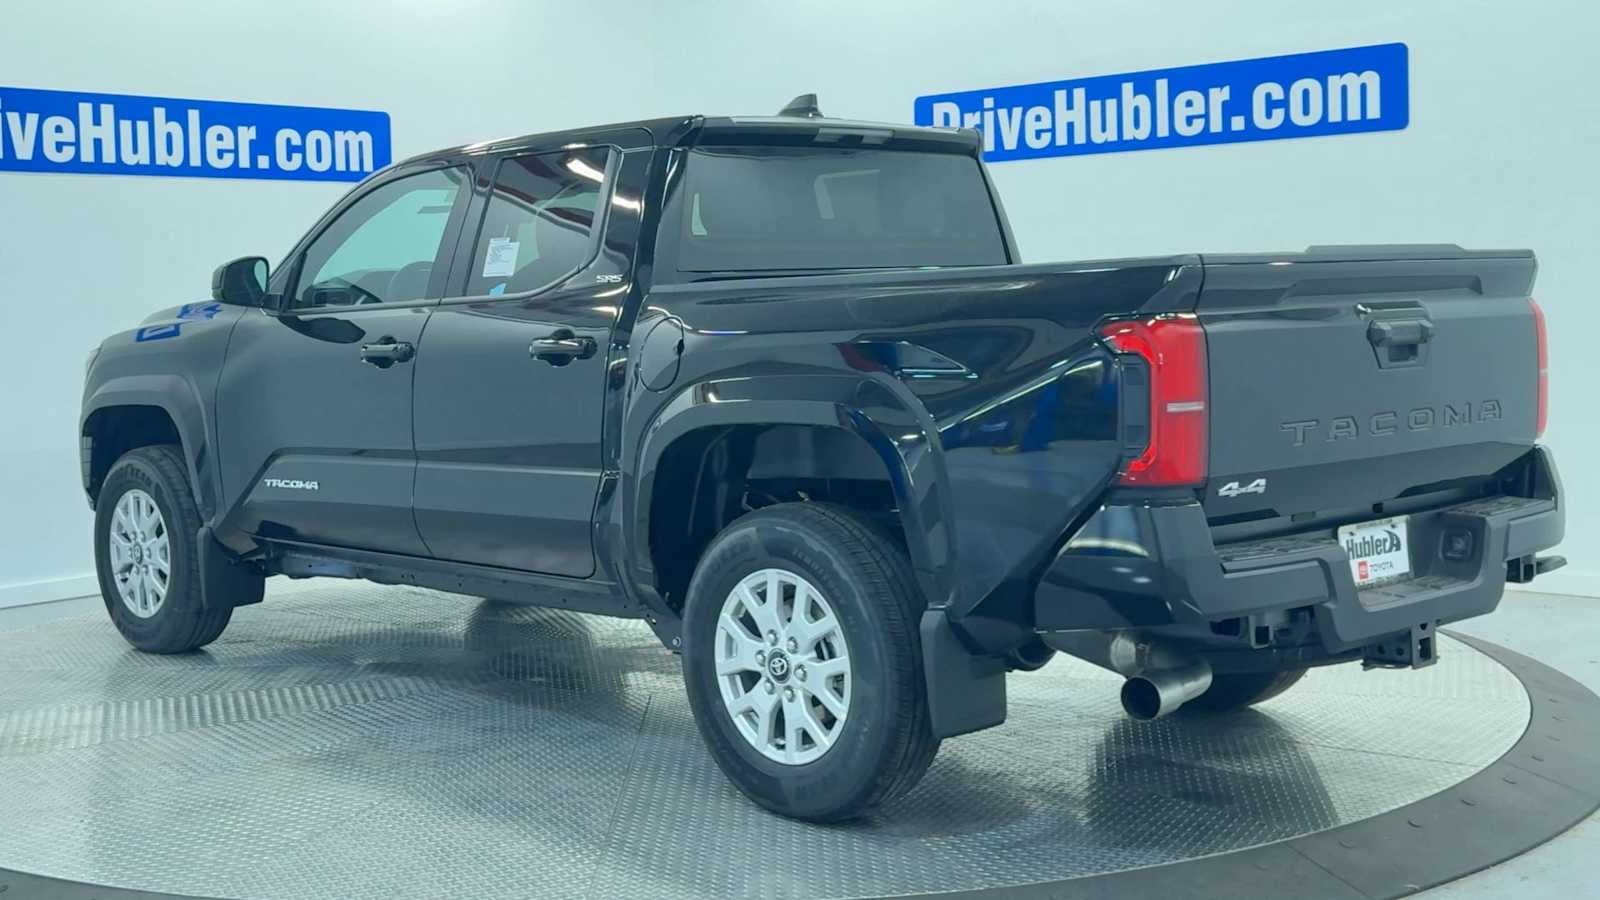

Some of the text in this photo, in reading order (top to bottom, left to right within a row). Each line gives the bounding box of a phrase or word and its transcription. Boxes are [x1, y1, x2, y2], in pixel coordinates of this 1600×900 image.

[0, 97, 374, 172] veHubler.com
[1280, 400, 1503, 447] TACOMA
[264, 478, 319, 490] TACOMA
